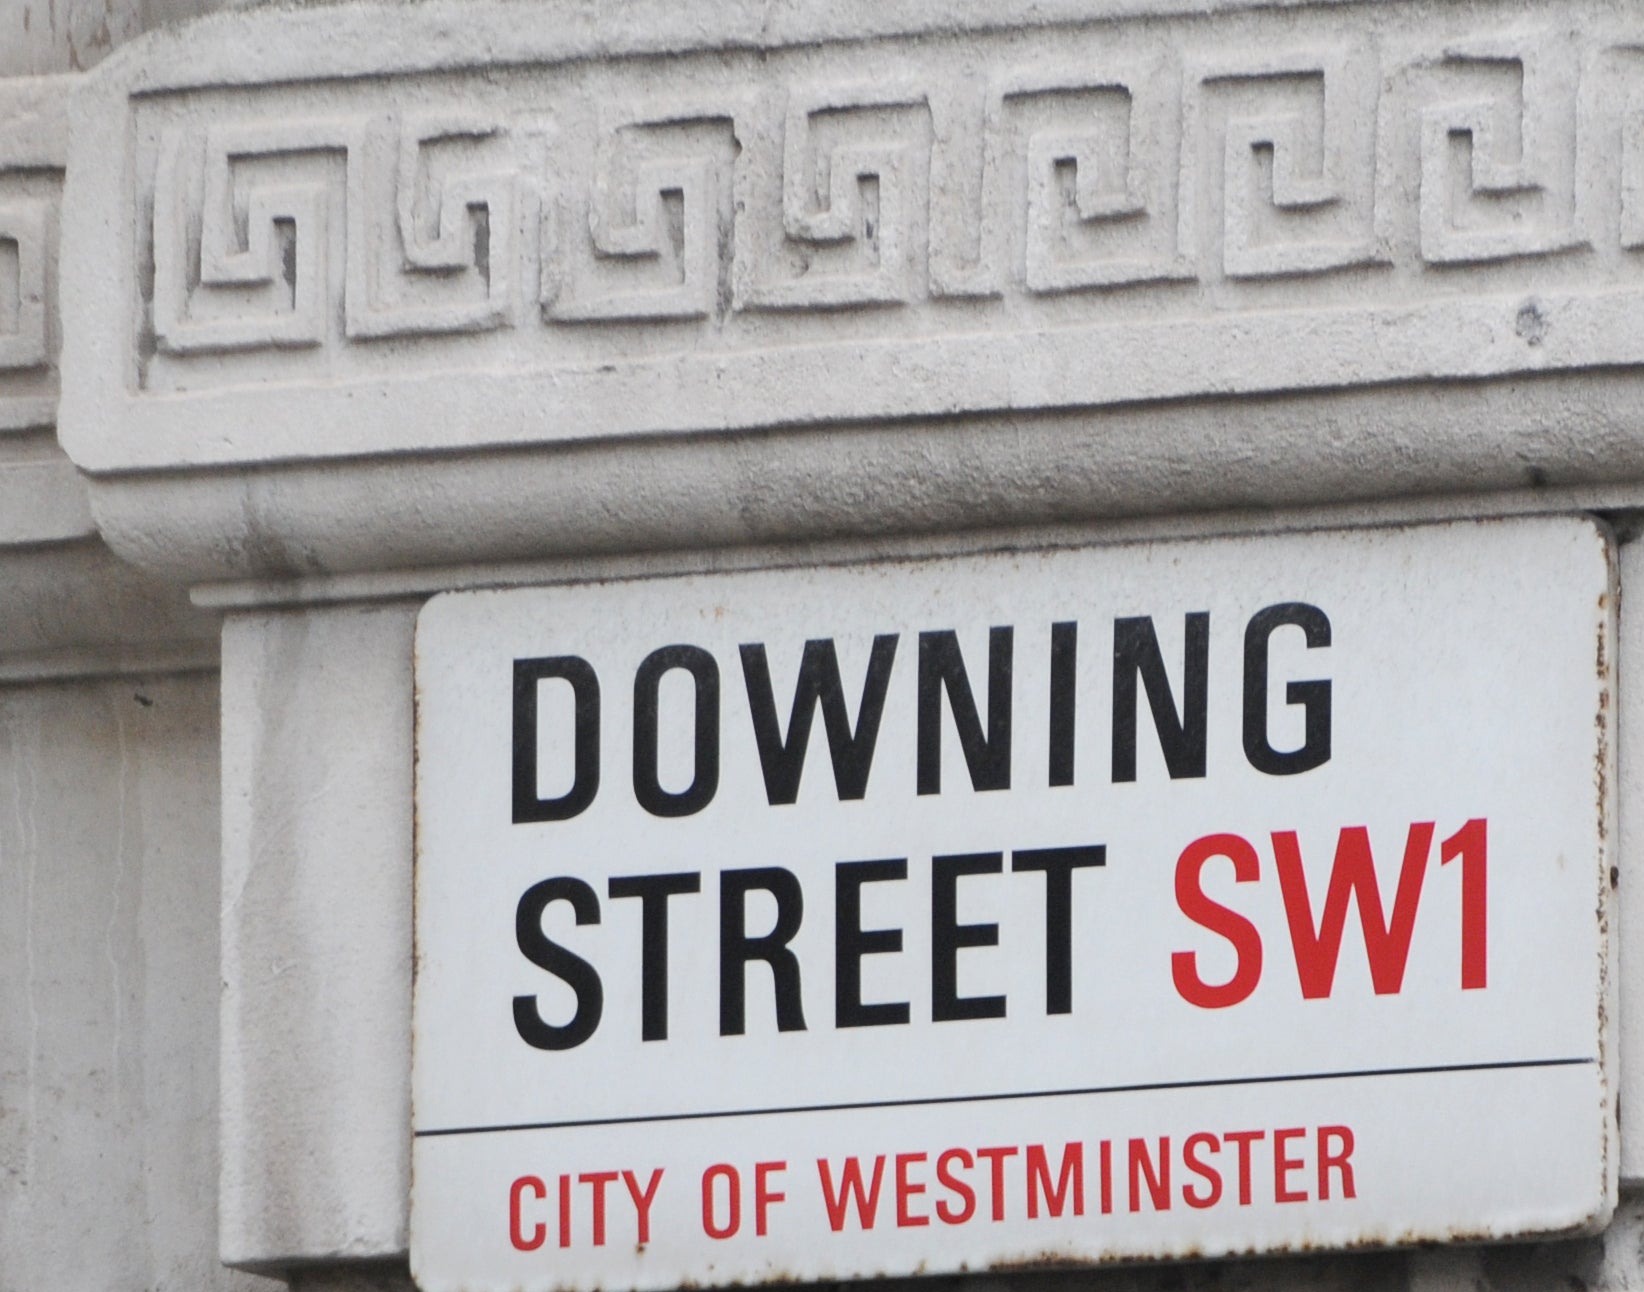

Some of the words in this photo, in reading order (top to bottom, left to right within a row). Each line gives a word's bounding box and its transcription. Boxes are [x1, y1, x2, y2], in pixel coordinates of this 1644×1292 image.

[512, 602, 1333, 824] DOWNING
[512, 845, 1107, 1051] STREET
[1170, 818, 1489, 1010] SW1
[508, 1168, 665, 1251] CITY
[701, 1161, 788, 1241] OF
[817, 1125, 1357, 1232] WESTMINSTER
